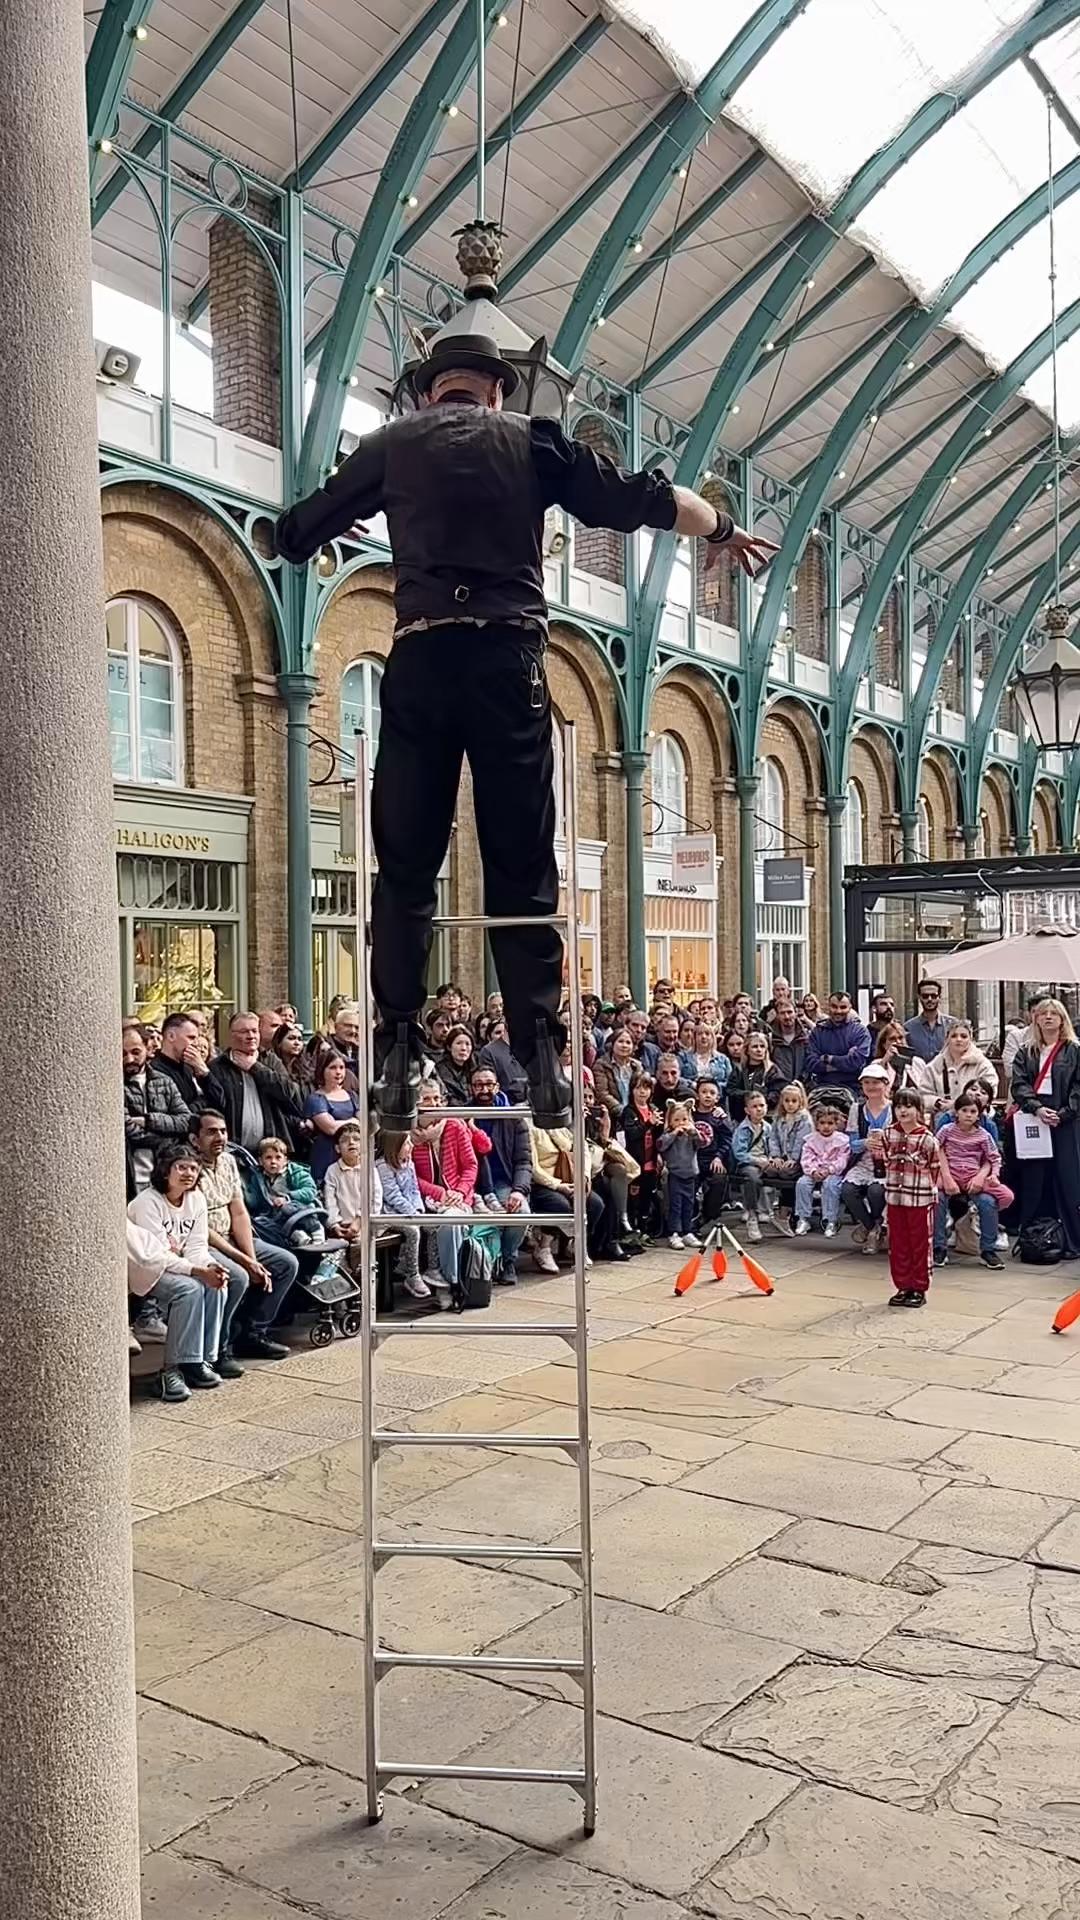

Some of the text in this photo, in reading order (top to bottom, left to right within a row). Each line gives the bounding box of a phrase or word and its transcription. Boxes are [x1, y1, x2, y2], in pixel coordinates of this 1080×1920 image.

[107, 663, 146, 685] PEL
[344, 712, 365, 728] PEA
[117, 828, 209, 852] HALIGON'S
